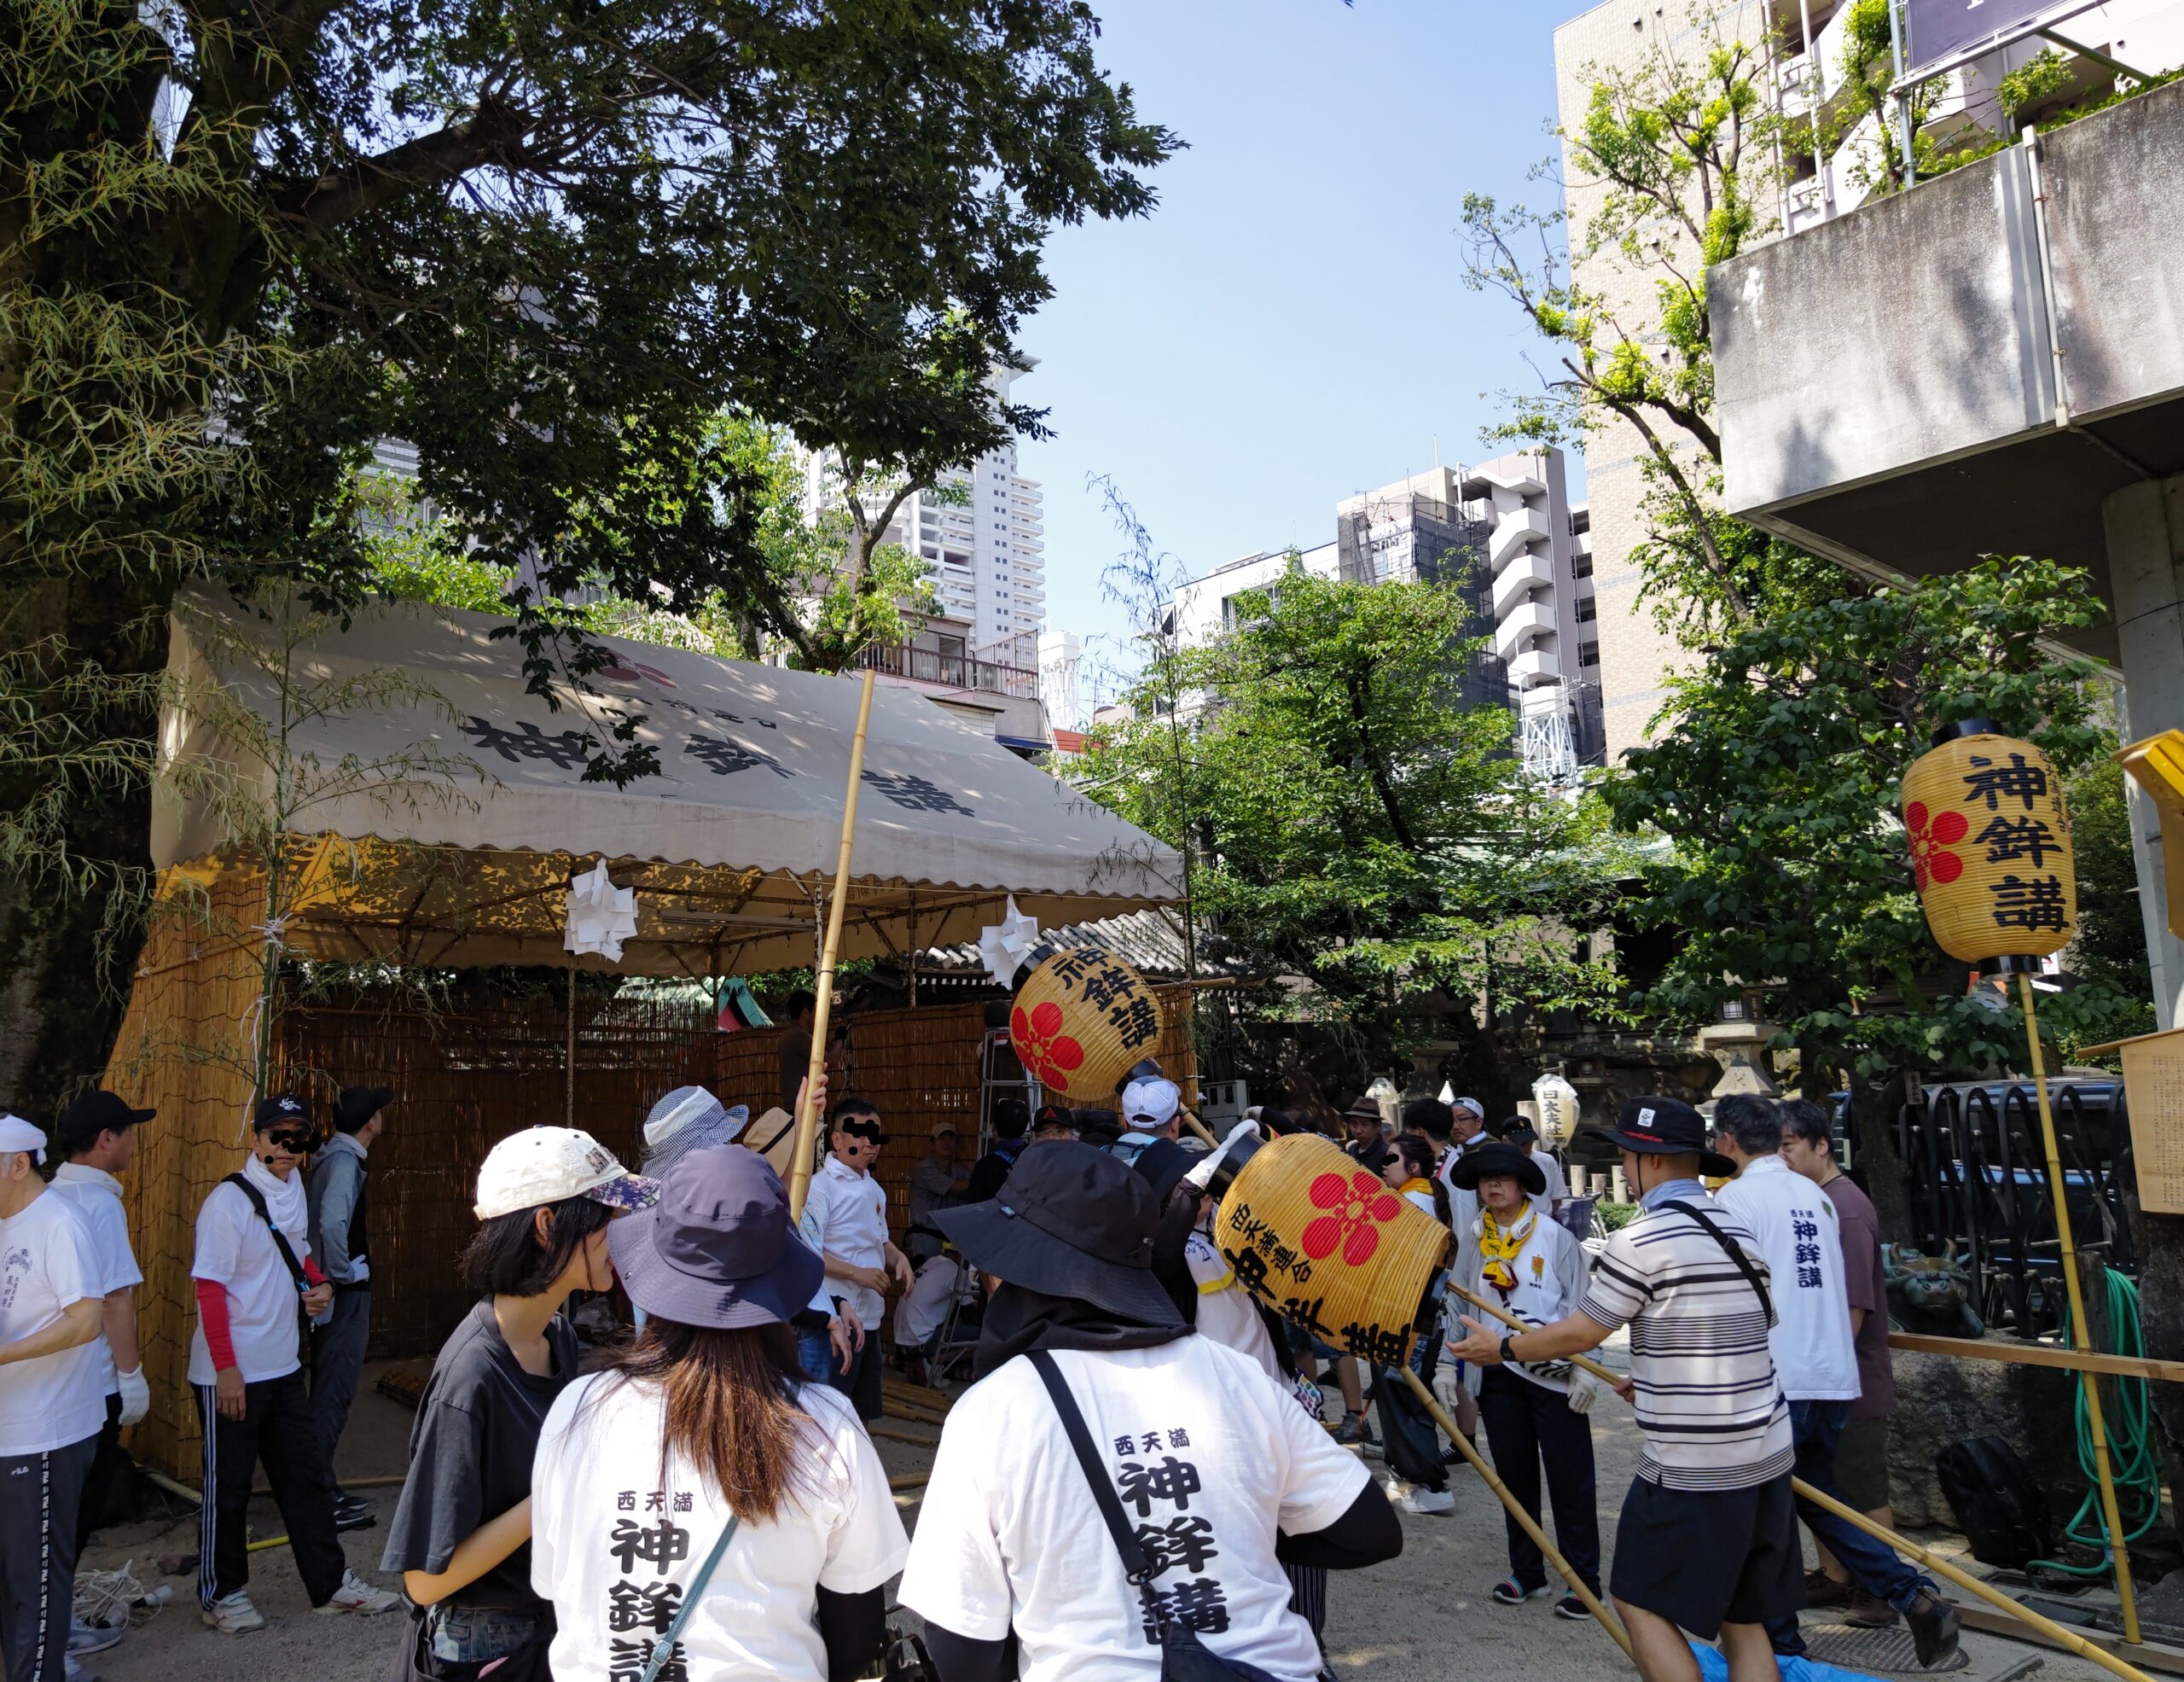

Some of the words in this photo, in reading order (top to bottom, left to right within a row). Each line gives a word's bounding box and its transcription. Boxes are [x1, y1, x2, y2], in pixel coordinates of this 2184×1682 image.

[1963, 753, 2070, 933] 神鉾講
[1051, 948, 1159, 1051] 神鉾講
[1230, 1202, 1312, 1284] 西天満連合
[1792, 1219, 1823, 1289] 神鉾講
[1113, 1427, 1190, 1457] 西天満
[617, 1490, 694, 1513] 西天満
[1118, 1456, 1231, 1645] 神鉾講
[608, 1518, 690, 1682] 神鉾講
